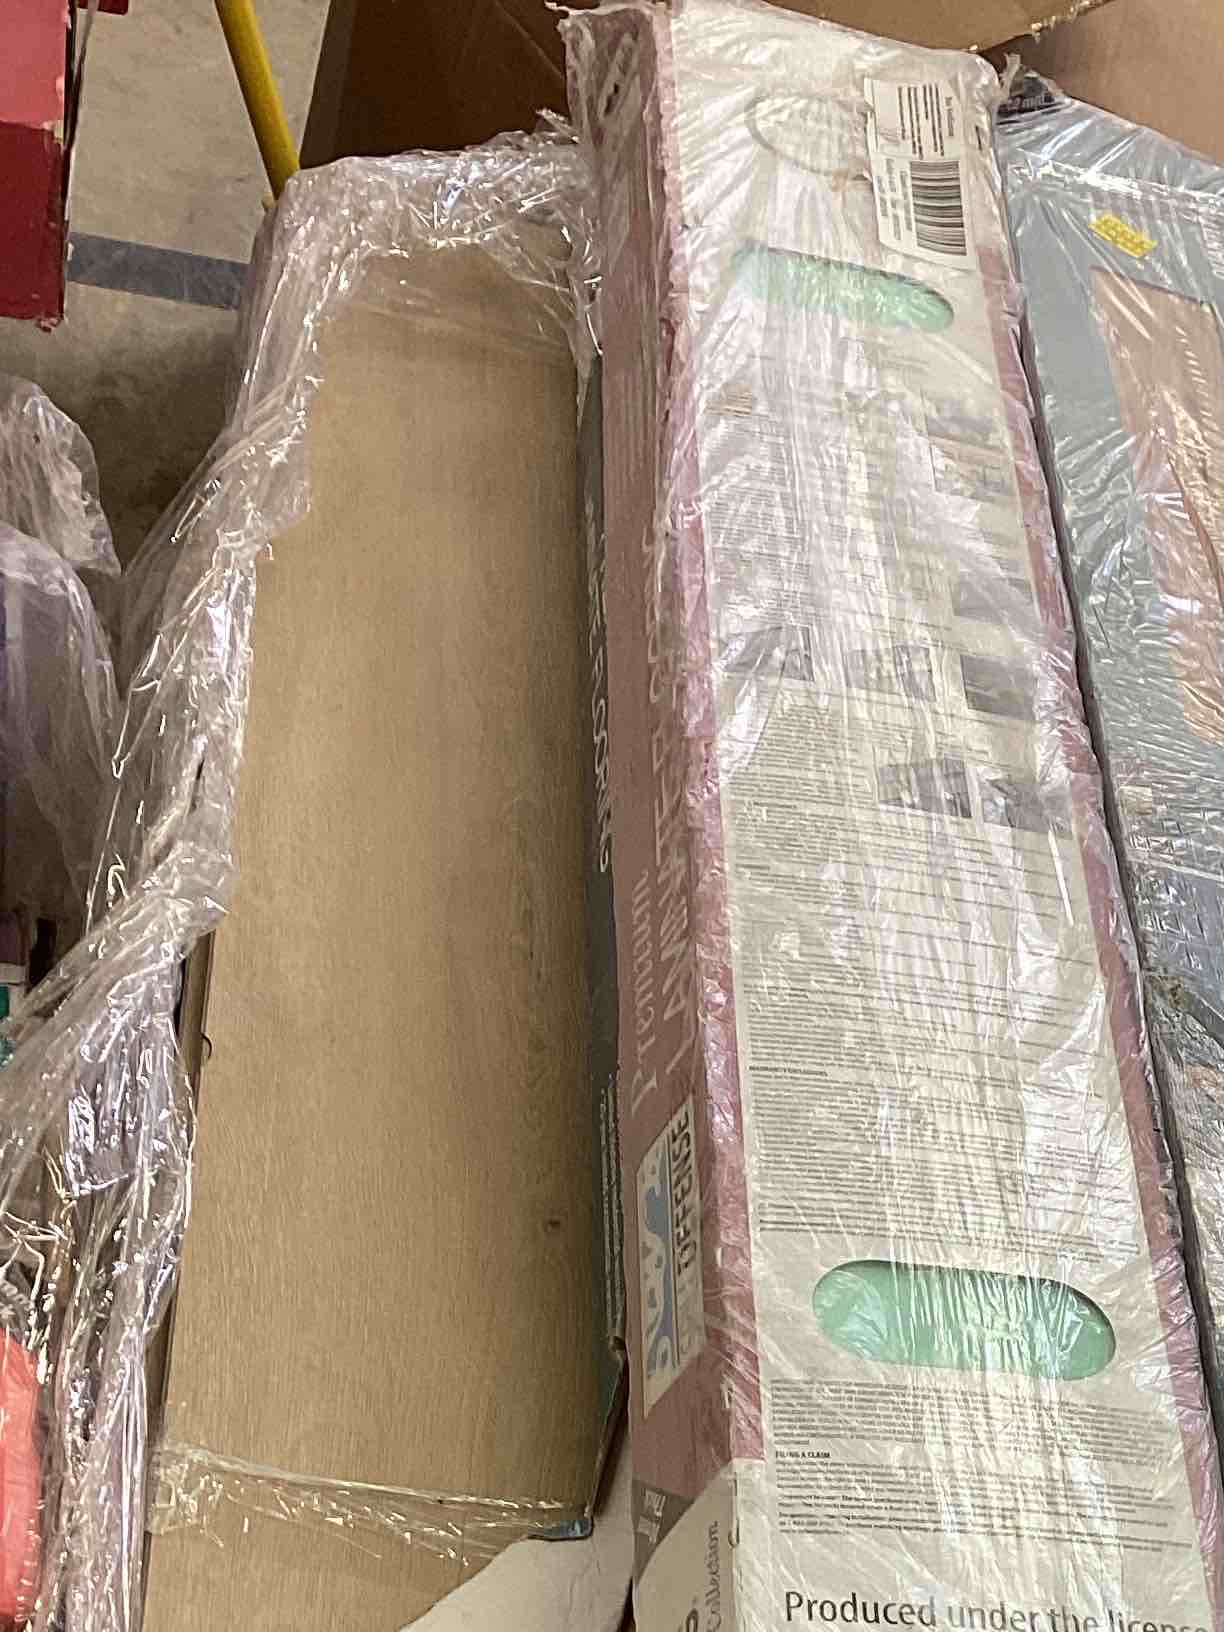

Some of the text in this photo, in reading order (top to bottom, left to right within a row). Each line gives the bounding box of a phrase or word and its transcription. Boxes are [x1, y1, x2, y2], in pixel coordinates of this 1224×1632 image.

[630, 868, 660, 1117] Premium
[671, 1108, 699, 1278] DEFENSE
[784, 1590, 937, 1628] Produced
